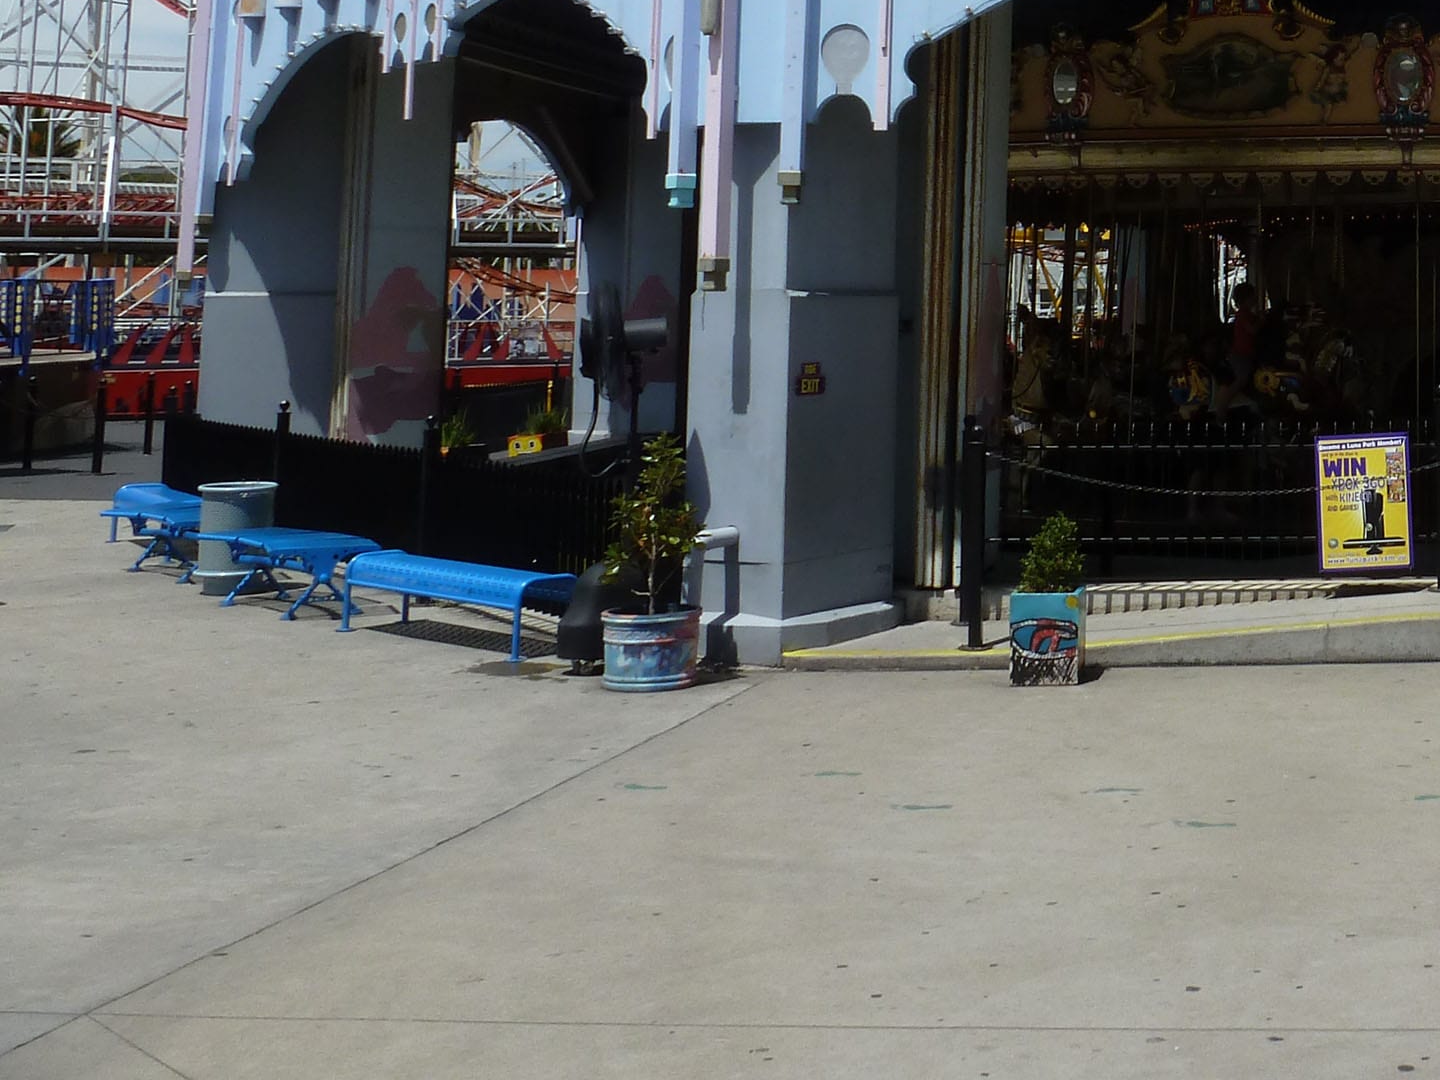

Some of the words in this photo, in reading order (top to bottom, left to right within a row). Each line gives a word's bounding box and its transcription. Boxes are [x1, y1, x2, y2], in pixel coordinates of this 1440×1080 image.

[801, 378, 820, 393] EXIT
[1323, 457, 1366, 477] WIN
[1332, 478, 1360, 491] XBOX
[1363, 476, 1386, 489] 360
